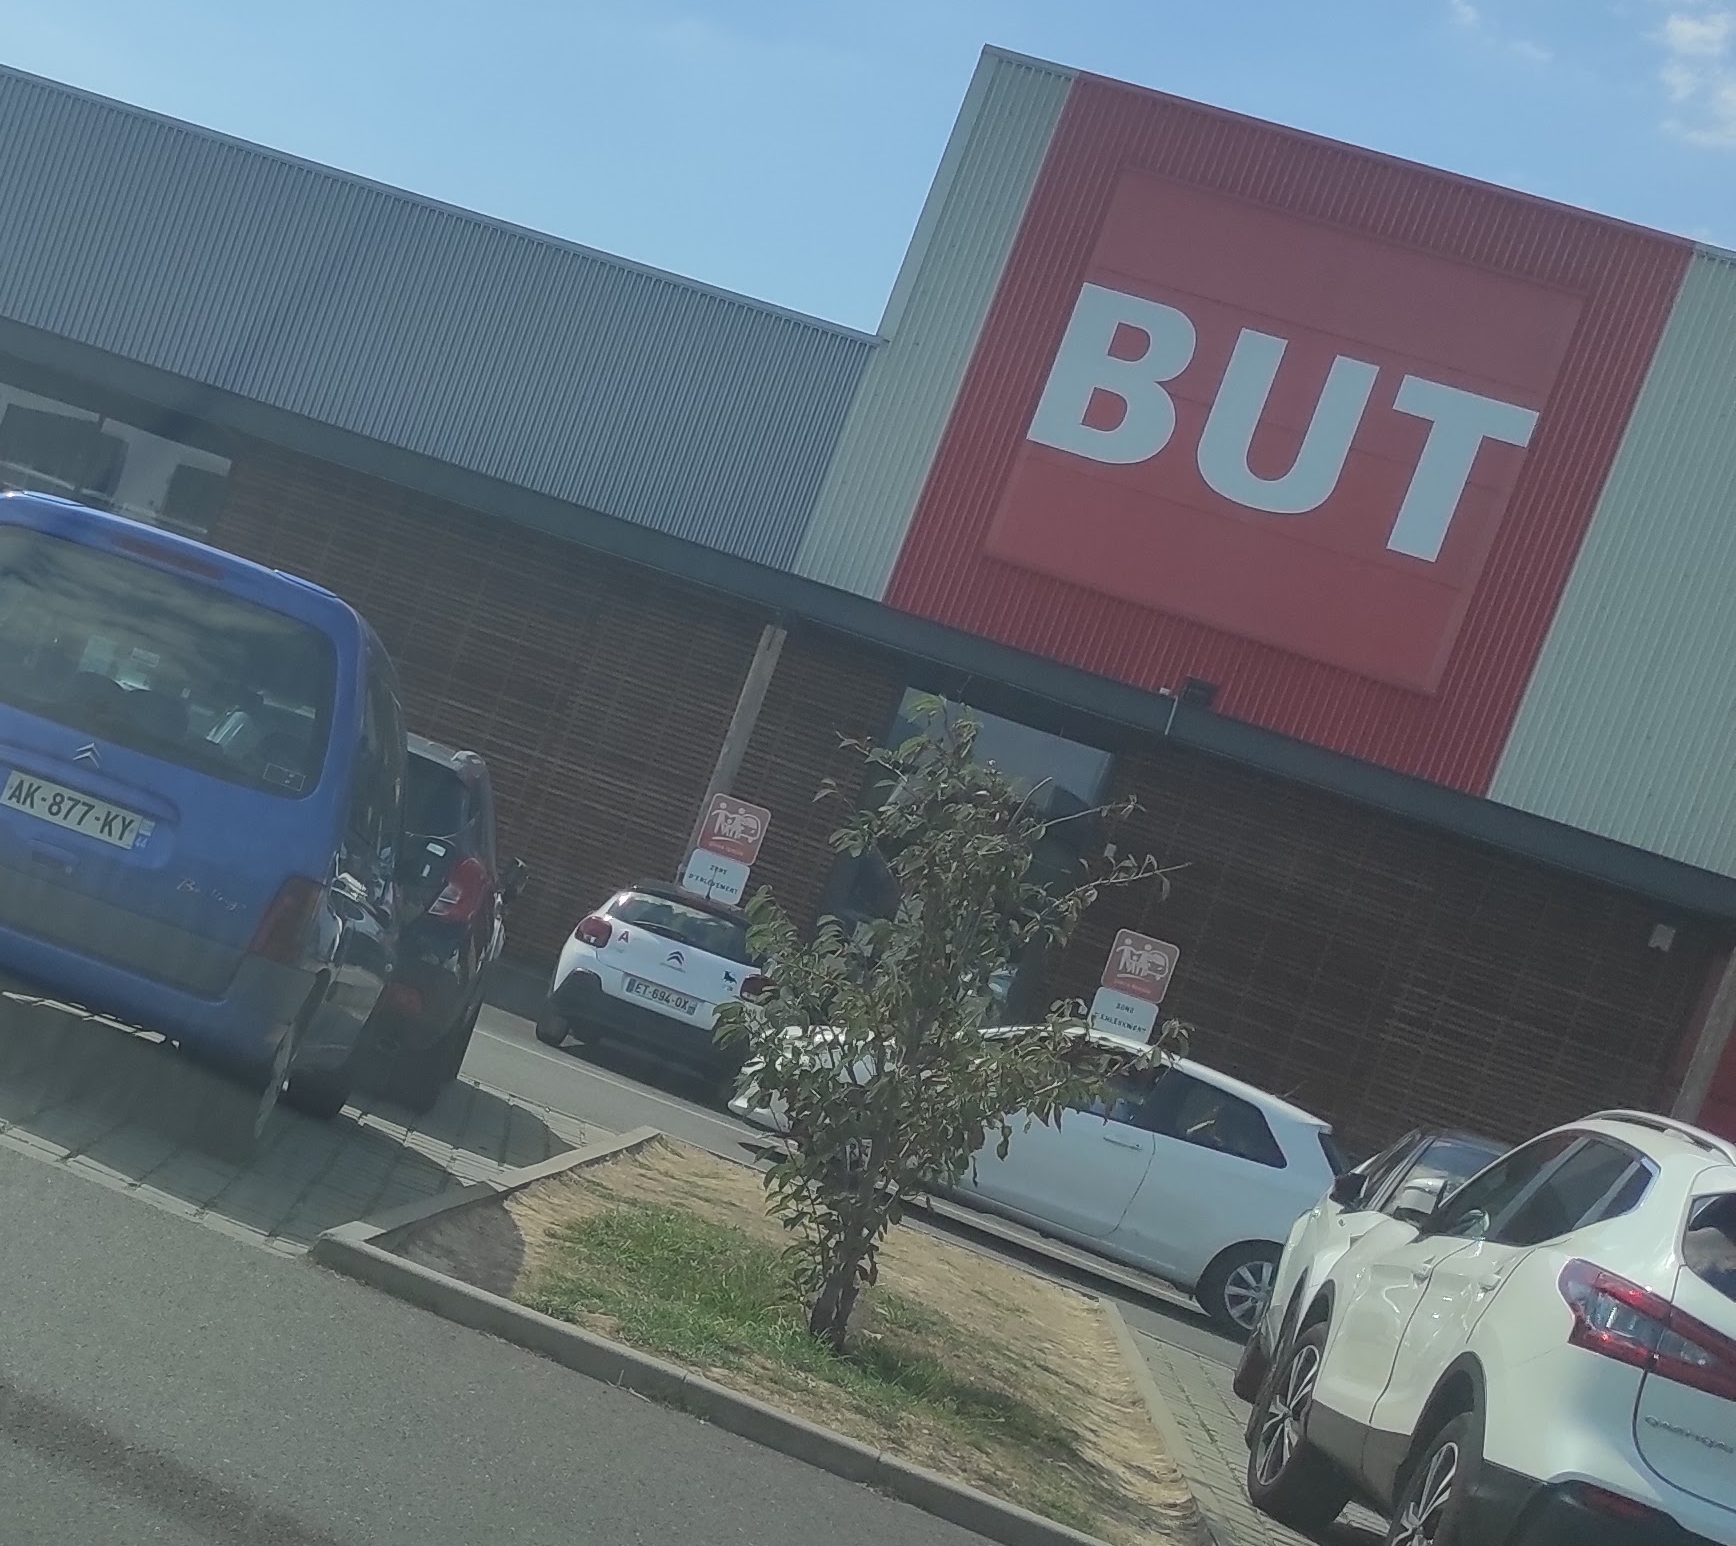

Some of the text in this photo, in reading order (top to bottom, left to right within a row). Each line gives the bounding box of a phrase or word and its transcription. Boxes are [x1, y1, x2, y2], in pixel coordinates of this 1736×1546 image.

[1026, 281, 1540, 564] BUT
[7, 779, 136, 842] AK-877-KY
[617, 930, 630, 944] A
